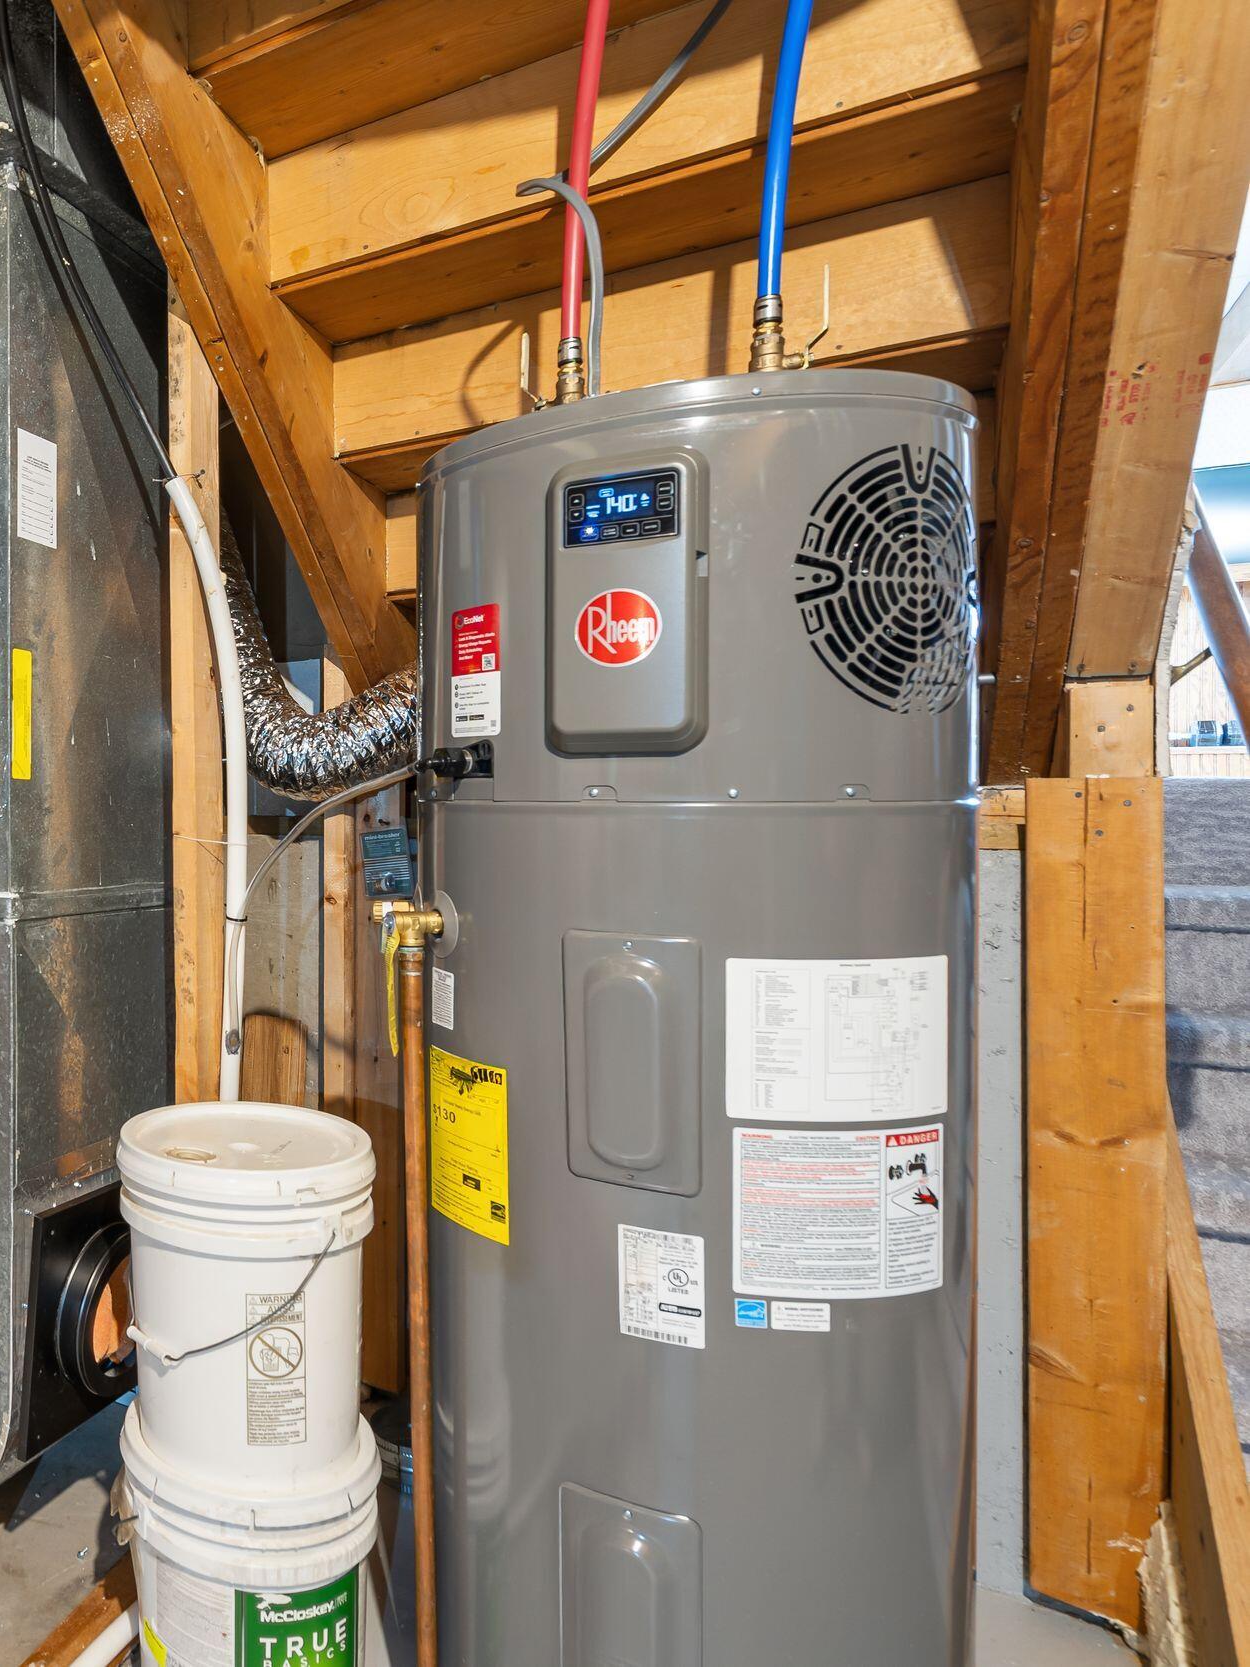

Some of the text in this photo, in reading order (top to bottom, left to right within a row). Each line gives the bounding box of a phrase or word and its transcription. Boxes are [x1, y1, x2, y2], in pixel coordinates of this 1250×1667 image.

[463, 615, 484, 625] EcoNet
[587, 592, 655, 654] Rheem
[897, 1130, 938, 1146] DANGER
[260, 1599, 335, 1623] McCloskey
[259, 1617, 348, 1659] TRUE
